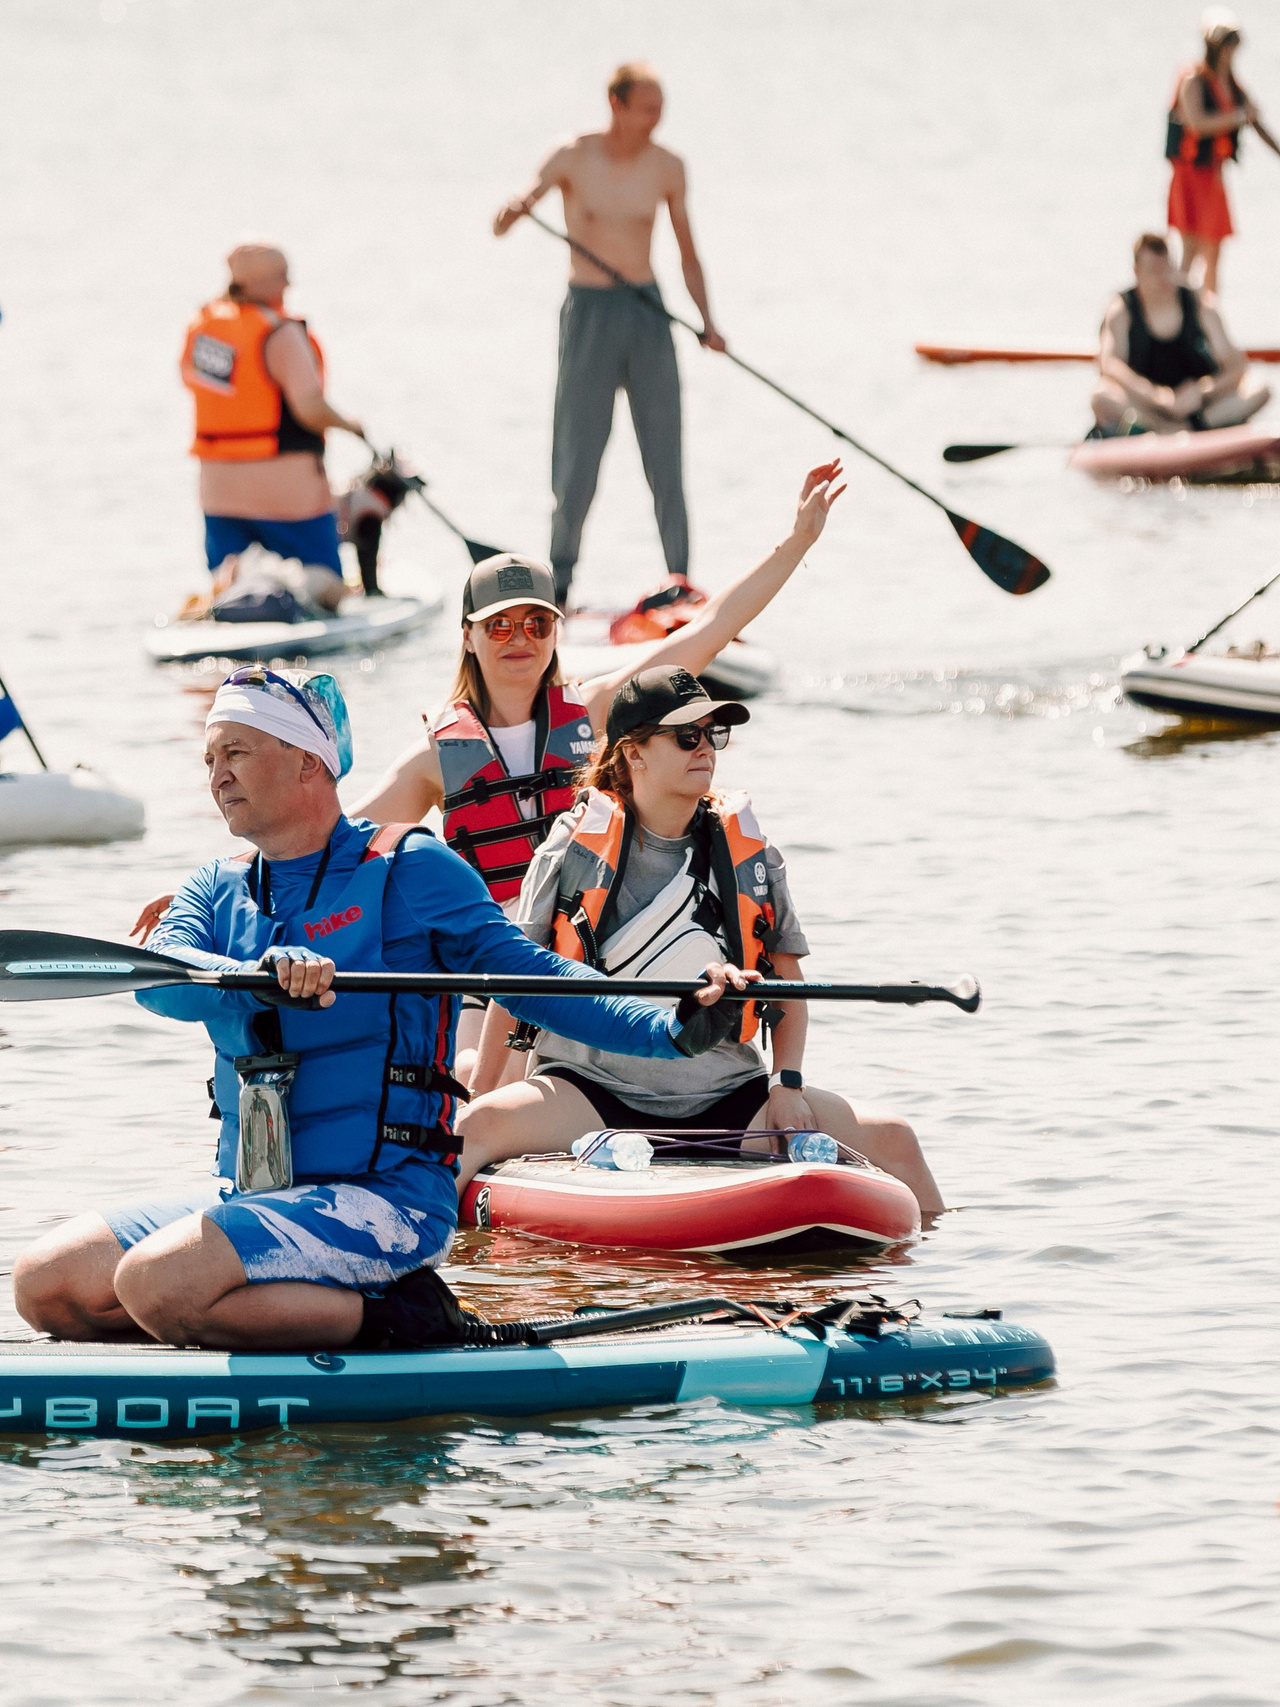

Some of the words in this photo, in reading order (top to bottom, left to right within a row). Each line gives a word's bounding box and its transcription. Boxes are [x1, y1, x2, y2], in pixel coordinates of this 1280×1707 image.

[569, 740, 600, 755] YAMA
[303, 904, 364, 942] hike
[389, 1067, 416, 1083] hi
[383, 1125, 411, 1141] hi
